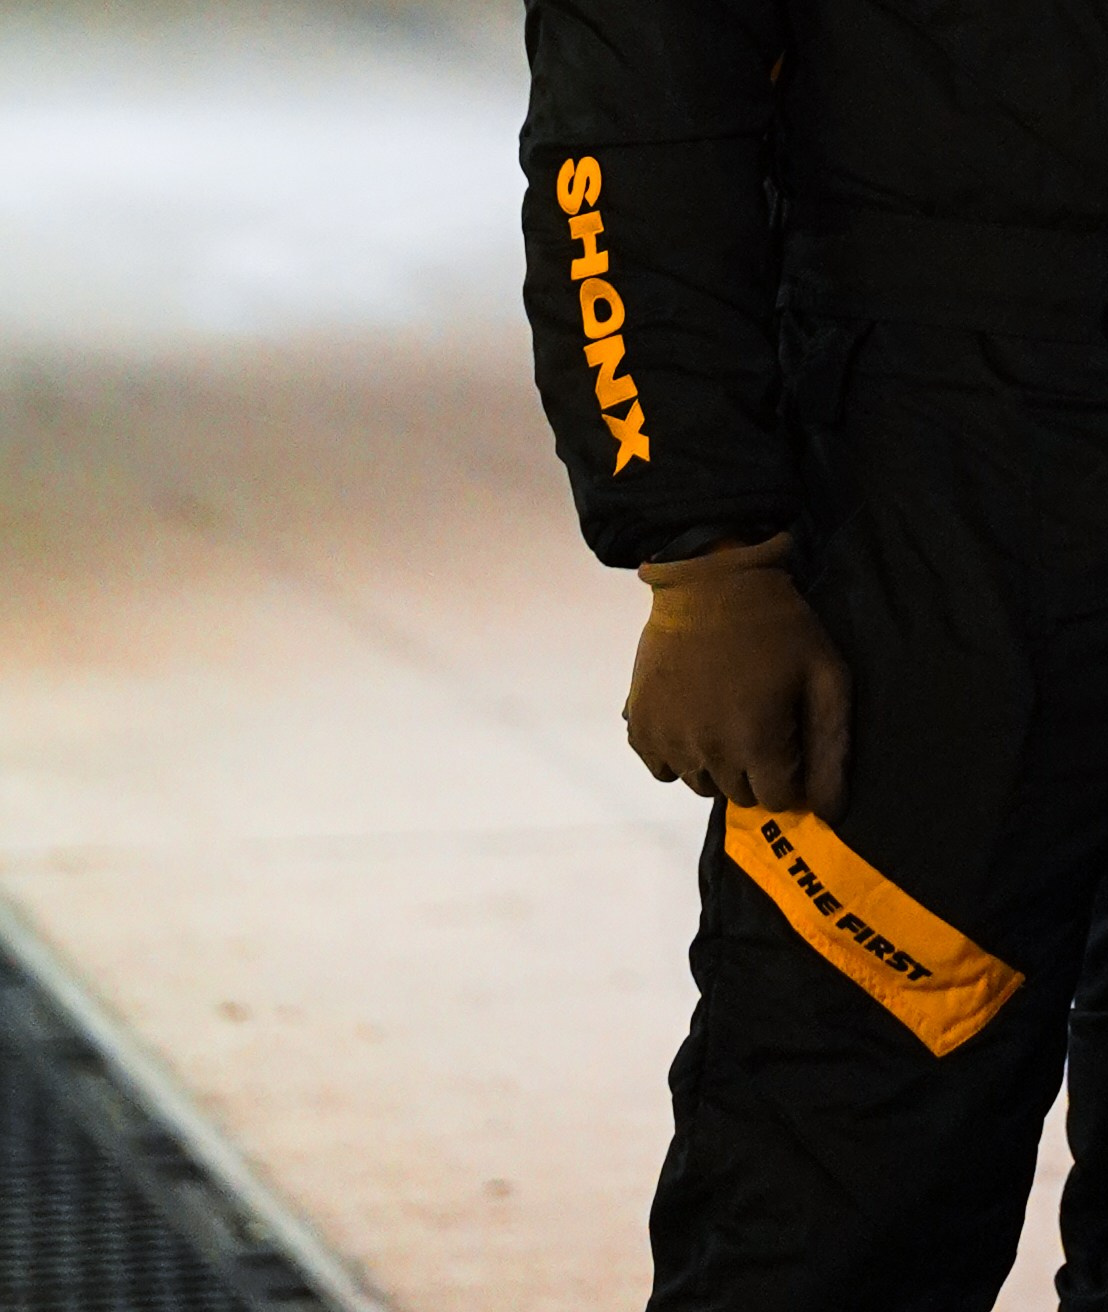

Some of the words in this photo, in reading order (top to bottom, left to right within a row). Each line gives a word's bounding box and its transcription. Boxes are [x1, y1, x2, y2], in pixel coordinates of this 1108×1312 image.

[556, 155, 650, 477] SHONX
[760, 819, 794, 860] BE
[787, 856, 844, 917] THE
[835, 912, 933, 982] FIRST
